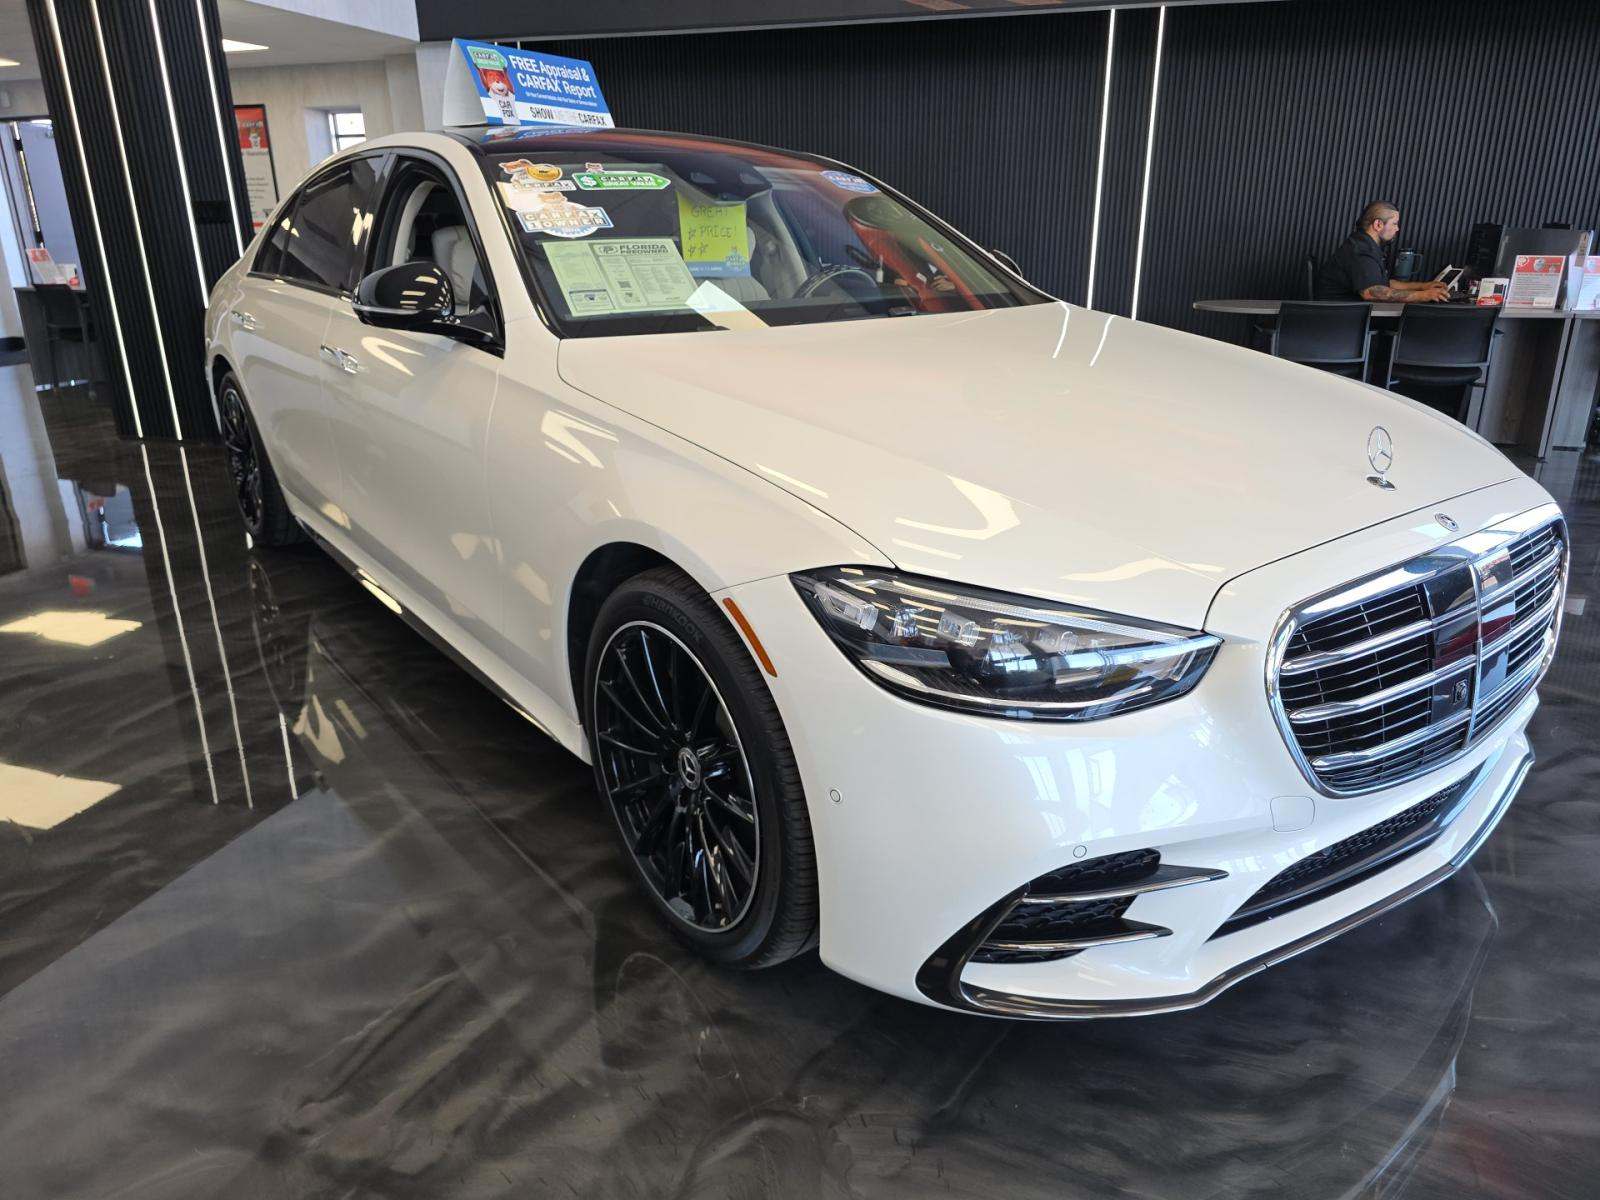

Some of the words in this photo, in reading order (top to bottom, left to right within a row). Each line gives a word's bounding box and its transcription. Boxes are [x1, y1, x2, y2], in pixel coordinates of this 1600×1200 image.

[508, 55, 541, 73] FREE
[540, 61, 580, 81] Appraisal
[581, 68, 590, 82] &
[517, 73, 560, 93] CARFAX
[563, 80, 597, 99] Report
[499, 100, 512, 110] CAR
[529, 106, 554, 120] SHOW
[578, 112, 607, 126] CARFAX
